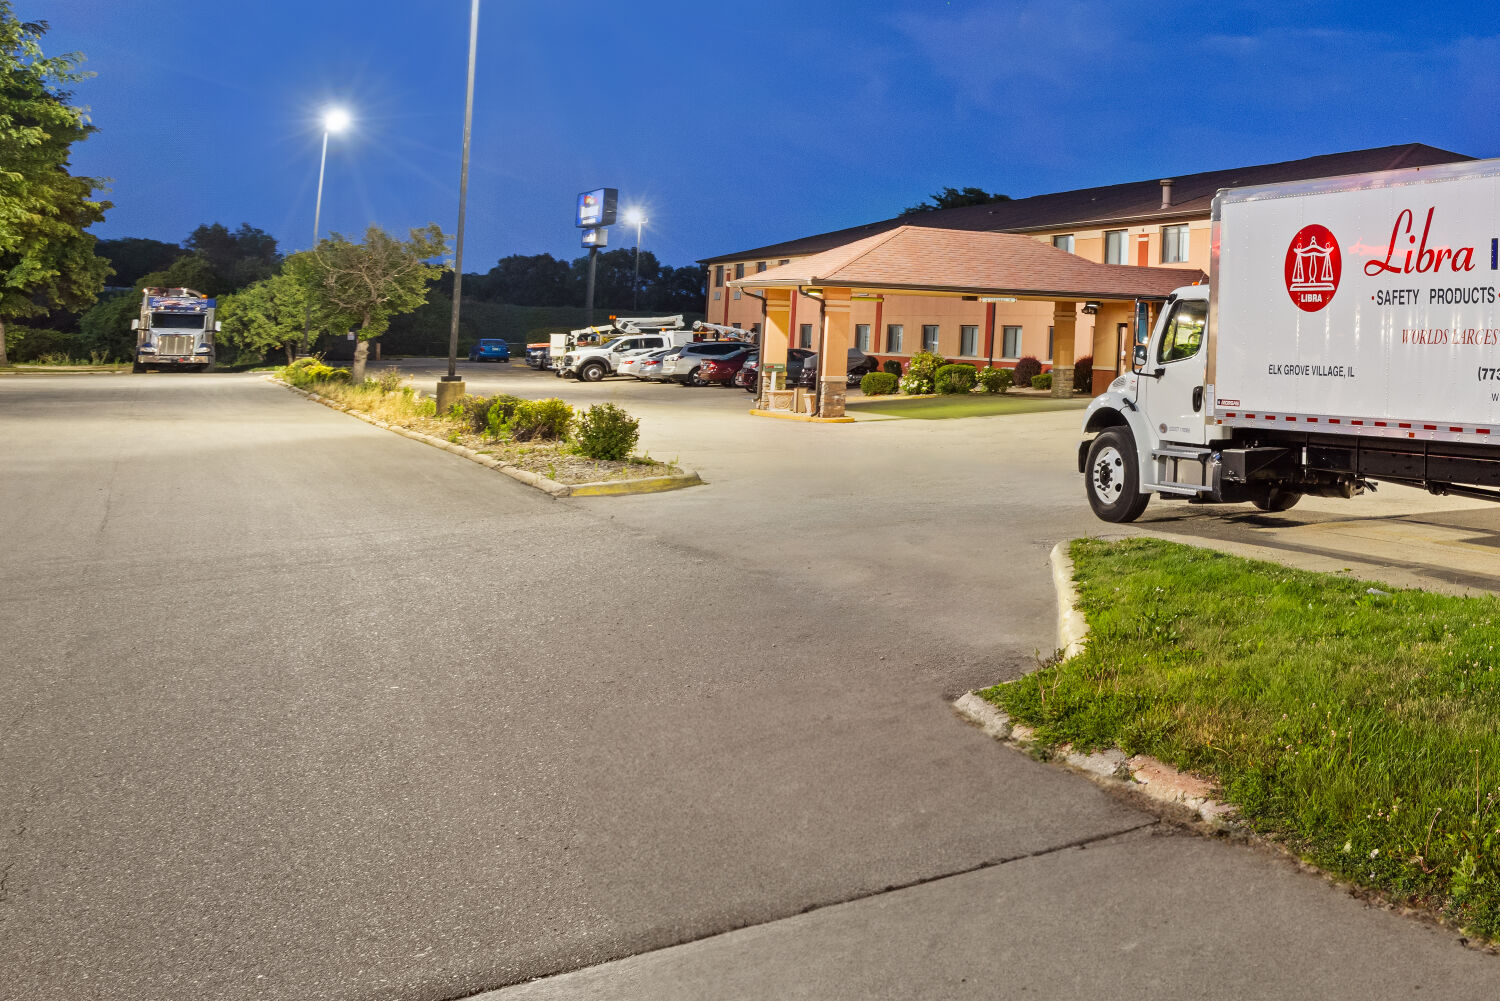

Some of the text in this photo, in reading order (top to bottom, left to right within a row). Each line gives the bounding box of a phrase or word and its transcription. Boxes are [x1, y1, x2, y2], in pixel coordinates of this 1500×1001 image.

[1363, 206, 1476, 276] Libra
[1300, 293, 1323, 303] LIBRA
[1376, 289, 1420, 305] SAFETY
[1429, 286, 1495, 305] PRODUCTS
[1401, 328, 1449, 345] WORLDS
[1268, 364, 1355, 379] ELK GROVE VILLAGE, IL
